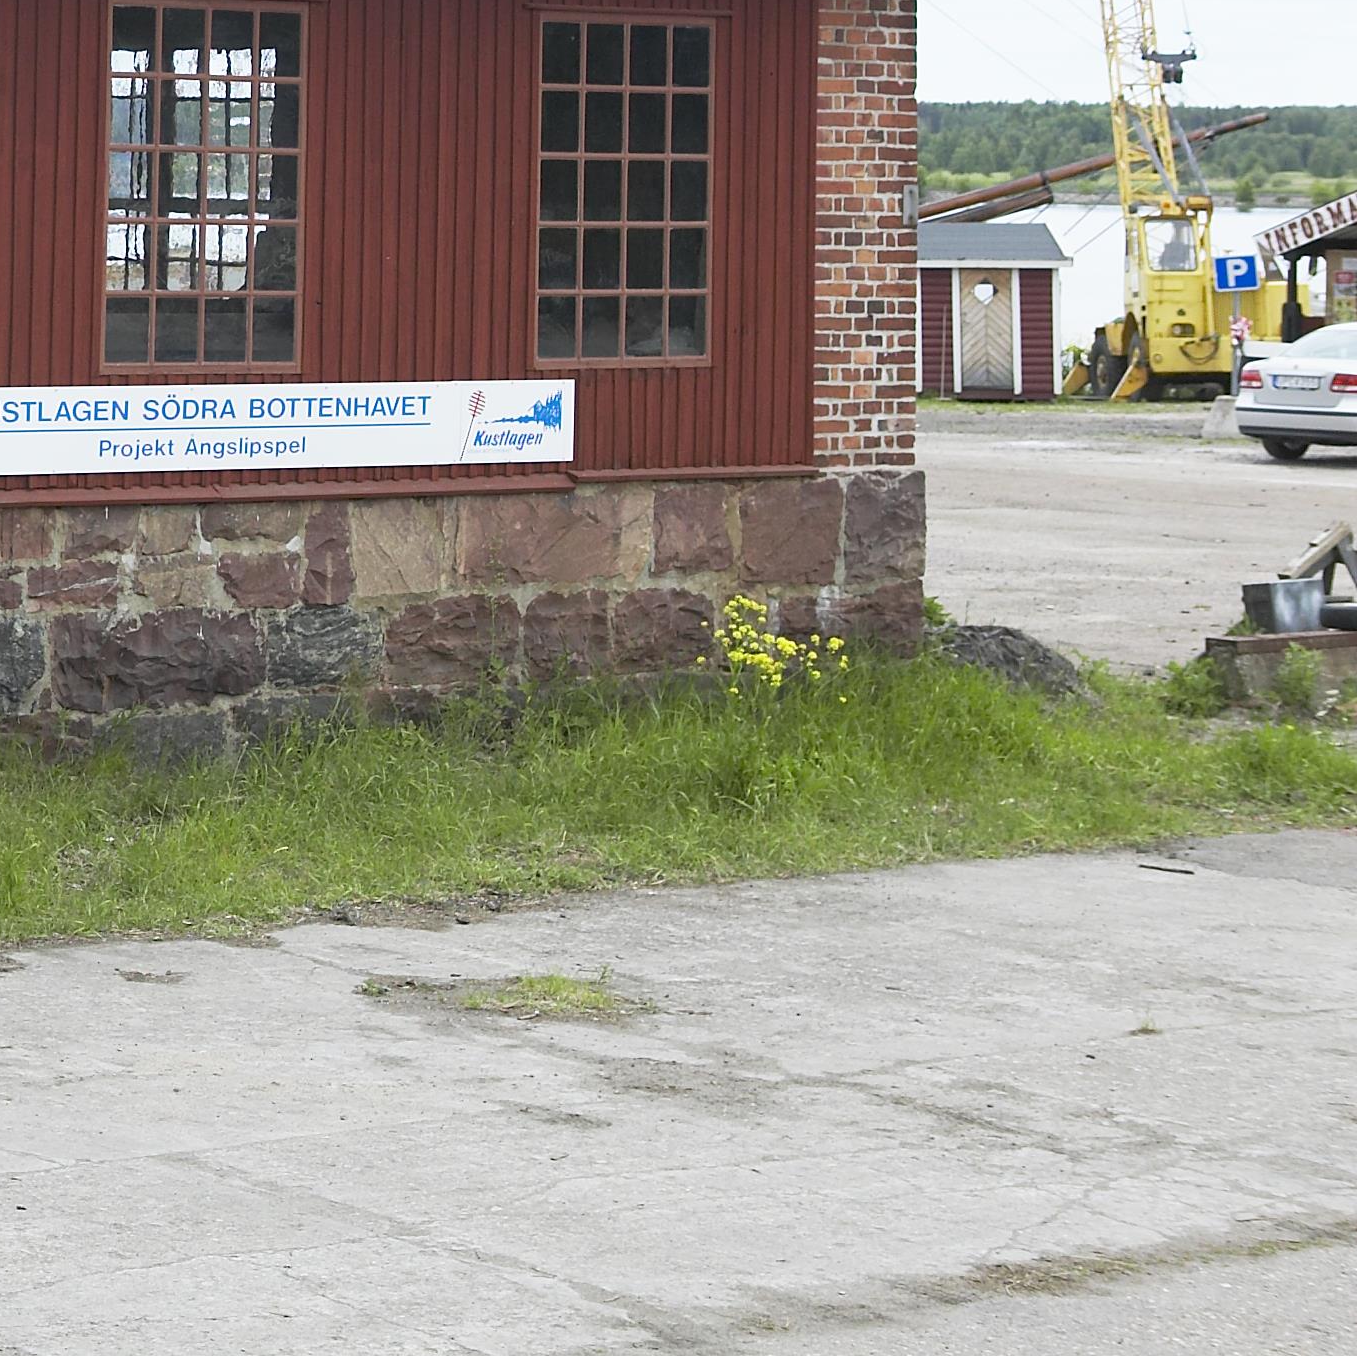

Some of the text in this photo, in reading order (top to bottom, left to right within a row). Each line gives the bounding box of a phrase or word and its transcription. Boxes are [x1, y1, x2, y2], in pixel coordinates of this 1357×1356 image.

[1226, 258, 1248, 288] P
[142, 394, 236, 421] SÖDRA
[249, 396, 432, 419] BOTTENHAVET
[99, 438, 174, 460] Projekt
[473, 429, 543, 451] Kustlagen
